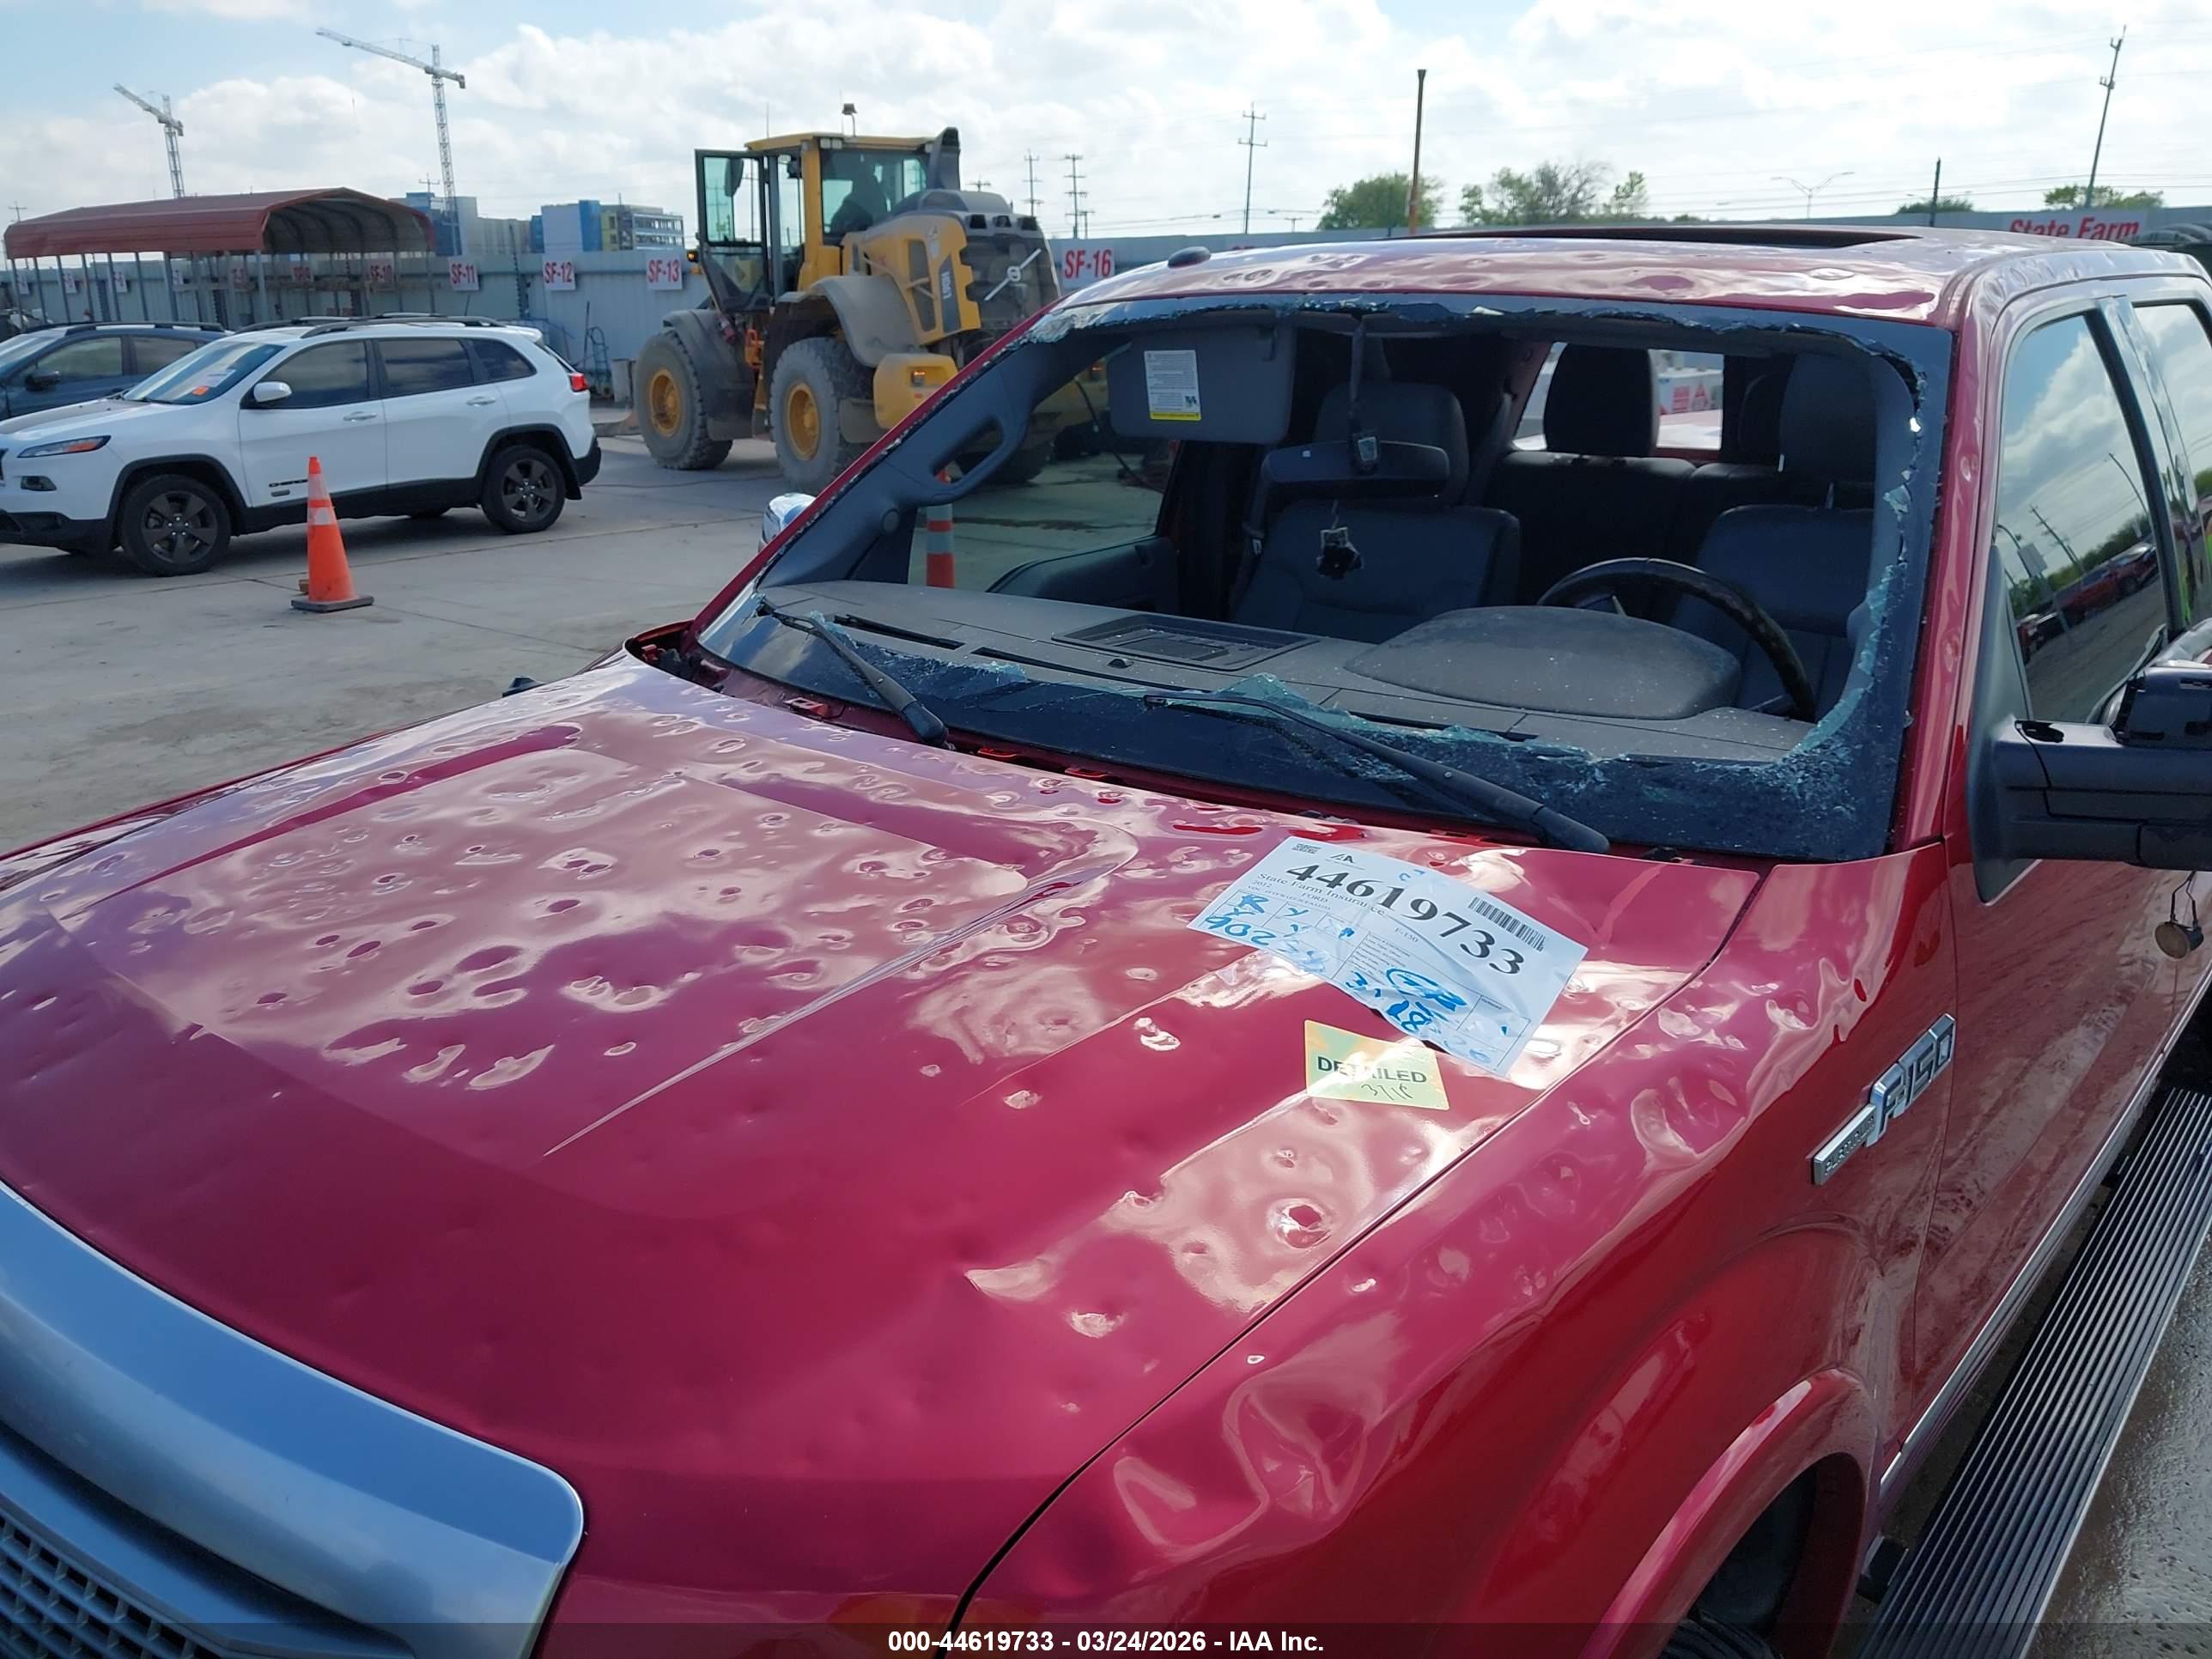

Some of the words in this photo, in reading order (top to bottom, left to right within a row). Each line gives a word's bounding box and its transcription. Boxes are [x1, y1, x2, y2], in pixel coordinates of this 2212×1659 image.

[2009, 219, 2069, 237] State
[2077, 216, 2140, 240] Farm
[452, 264, 476, 284] SF-11
[544, 262, 573, 283] SF-12
[648, 259, 680, 283] SF-13
[1064, 249, 1113, 279] SF-16
[1257, 872, 1288, 885] State
[1291, 880, 1323, 895] Farm
[1286, 864, 1525, 975] 44619733
[1318, 1056, 1427, 1084] DEILED
